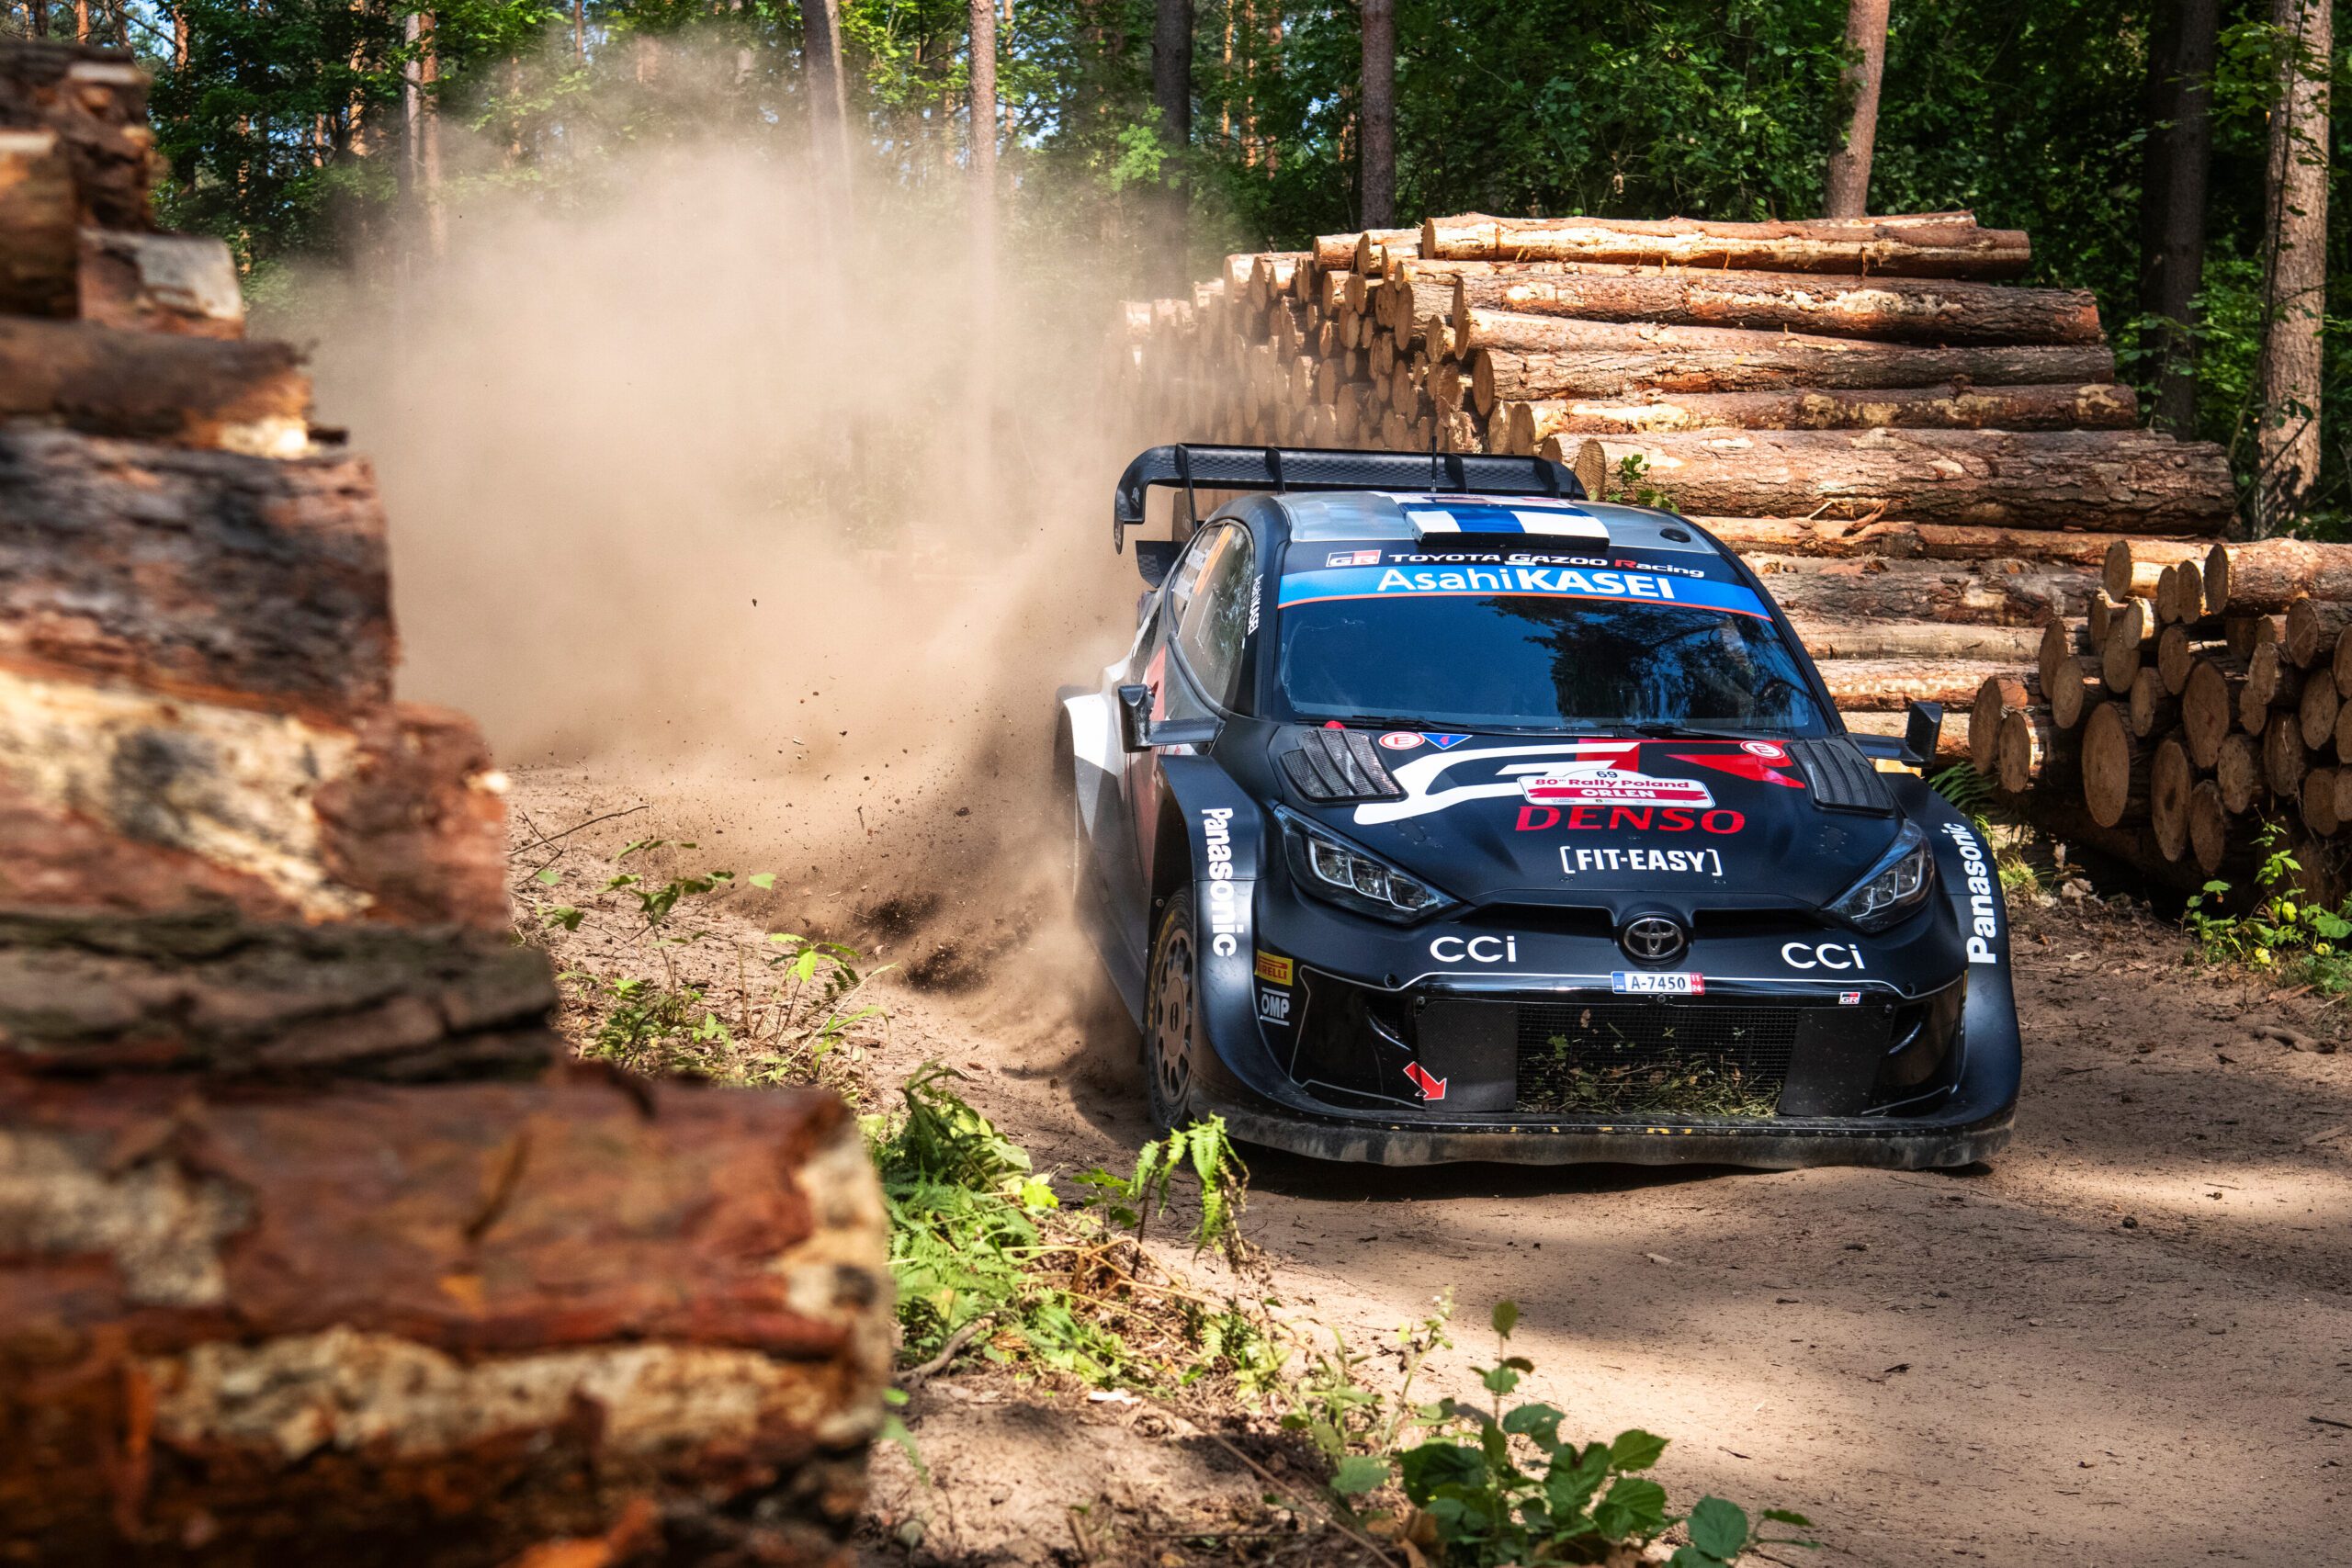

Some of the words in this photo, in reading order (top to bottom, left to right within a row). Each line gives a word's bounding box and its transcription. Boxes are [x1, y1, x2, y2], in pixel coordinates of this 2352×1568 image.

[1329, 555, 1378, 566] GR
[1388, 554, 1501, 562] TOYOTA
[1505, 553, 1608, 566] GAZOO
[1614, 559, 1705, 578] Racing
[1568, 779, 1617, 787] Rally
[1621, 780, 1690, 788] Poland
[1580, 789, 1656, 797] ORLEN
[1515, 806, 1745, 834] DENSO
[1202, 807, 1244, 957] Panasonic
[1940, 822, 1996, 964] Panasonic
[1258, 955, 1288, 980] PIRELLI
[1631, 976, 1686, 990] A-7450
[1261, 993, 1290, 1019] OMP
